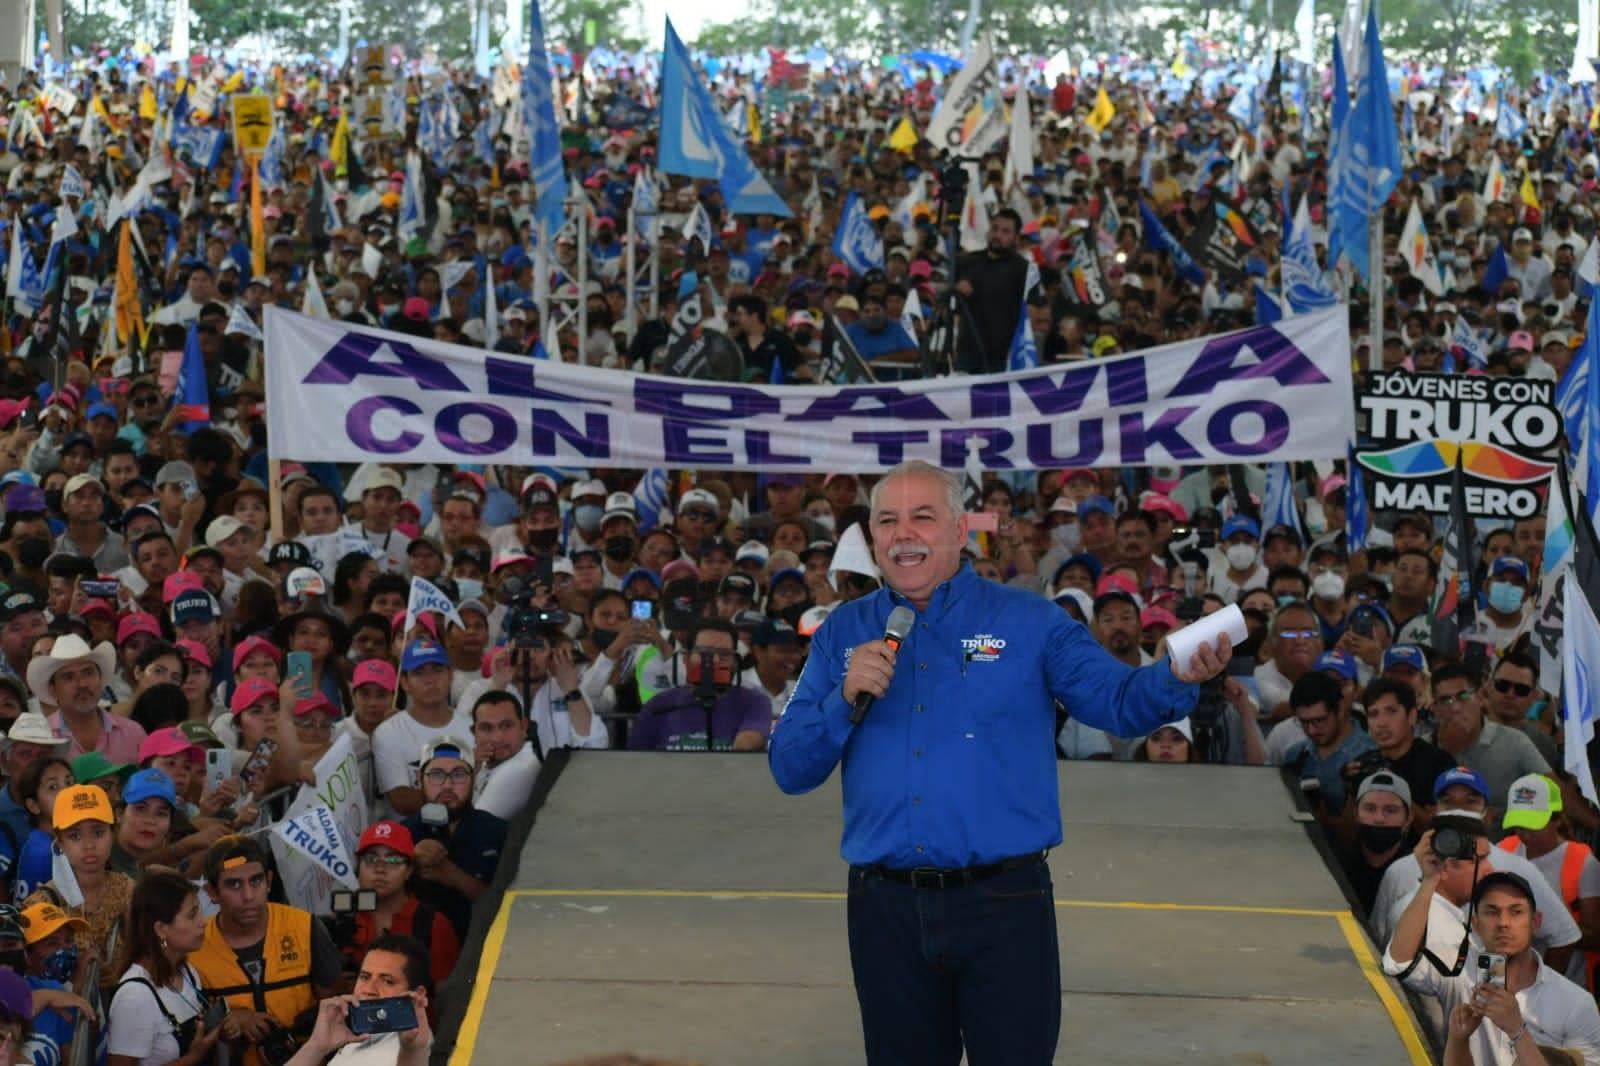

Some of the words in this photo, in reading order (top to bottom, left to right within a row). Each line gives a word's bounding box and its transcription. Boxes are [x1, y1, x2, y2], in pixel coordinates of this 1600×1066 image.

[301, 323, 1332, 421] ALDAMA
[1372, 371, 1487, 400] JÓVENES
[1493, 381, 1550, 404] CON
[345, 395, 611, 459] CON
[663, 416, 812, 465] EL
[852, 399, 1290, 469] TRUKO
[1361, 396, 1559, 448] TRUKO
[1375, 481, 1537, 517] MADERO
[960, 638, 1007, 650] TRUKO
[285, 819, 349, 878] TRUKO
[316, 807, 340, 850] ALDAMA
